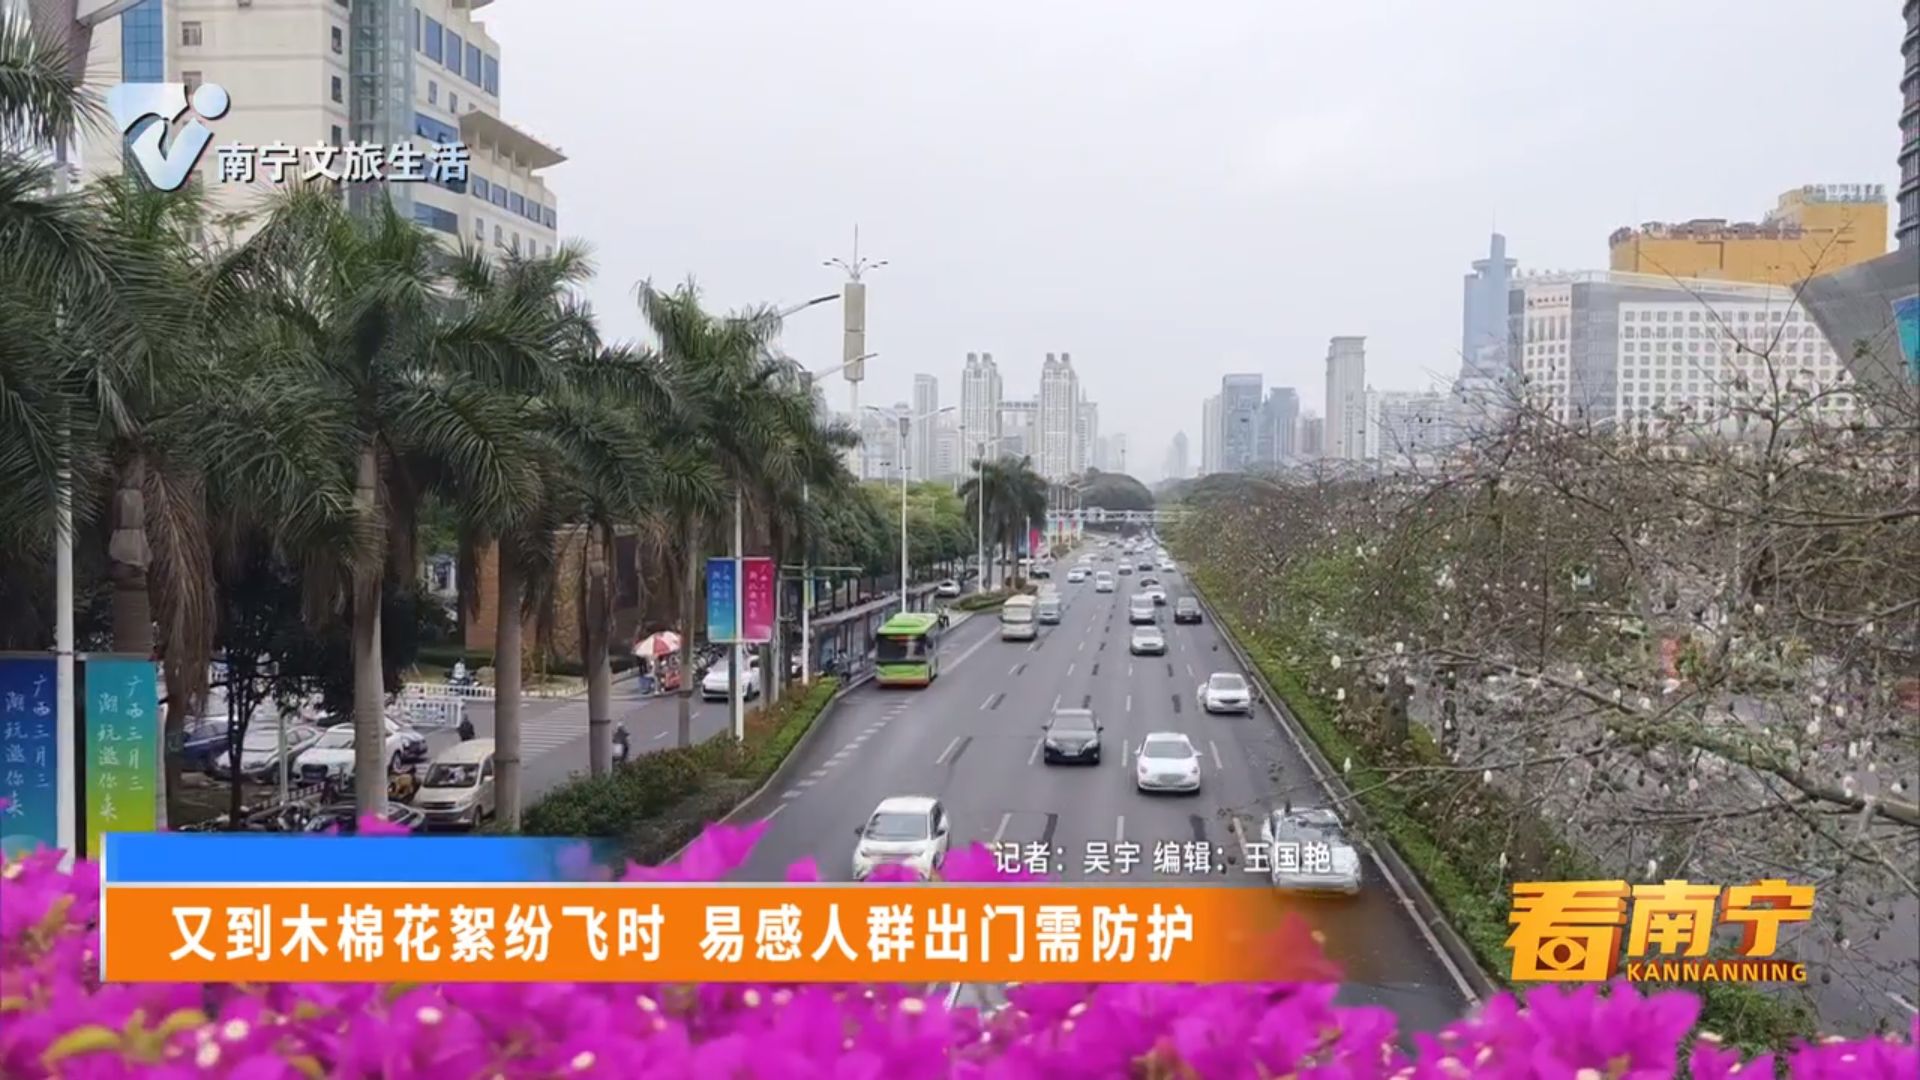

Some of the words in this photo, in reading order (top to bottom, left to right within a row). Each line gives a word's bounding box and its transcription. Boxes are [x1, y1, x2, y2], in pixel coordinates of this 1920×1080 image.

[4, 692, 28, 817] 潮玩邀你来
[32, 674, 51, 788] 广西三月三
[97, 693, 122, 821] 潮玩邀你来
[125, 675, 144, 791] 广西三月三
